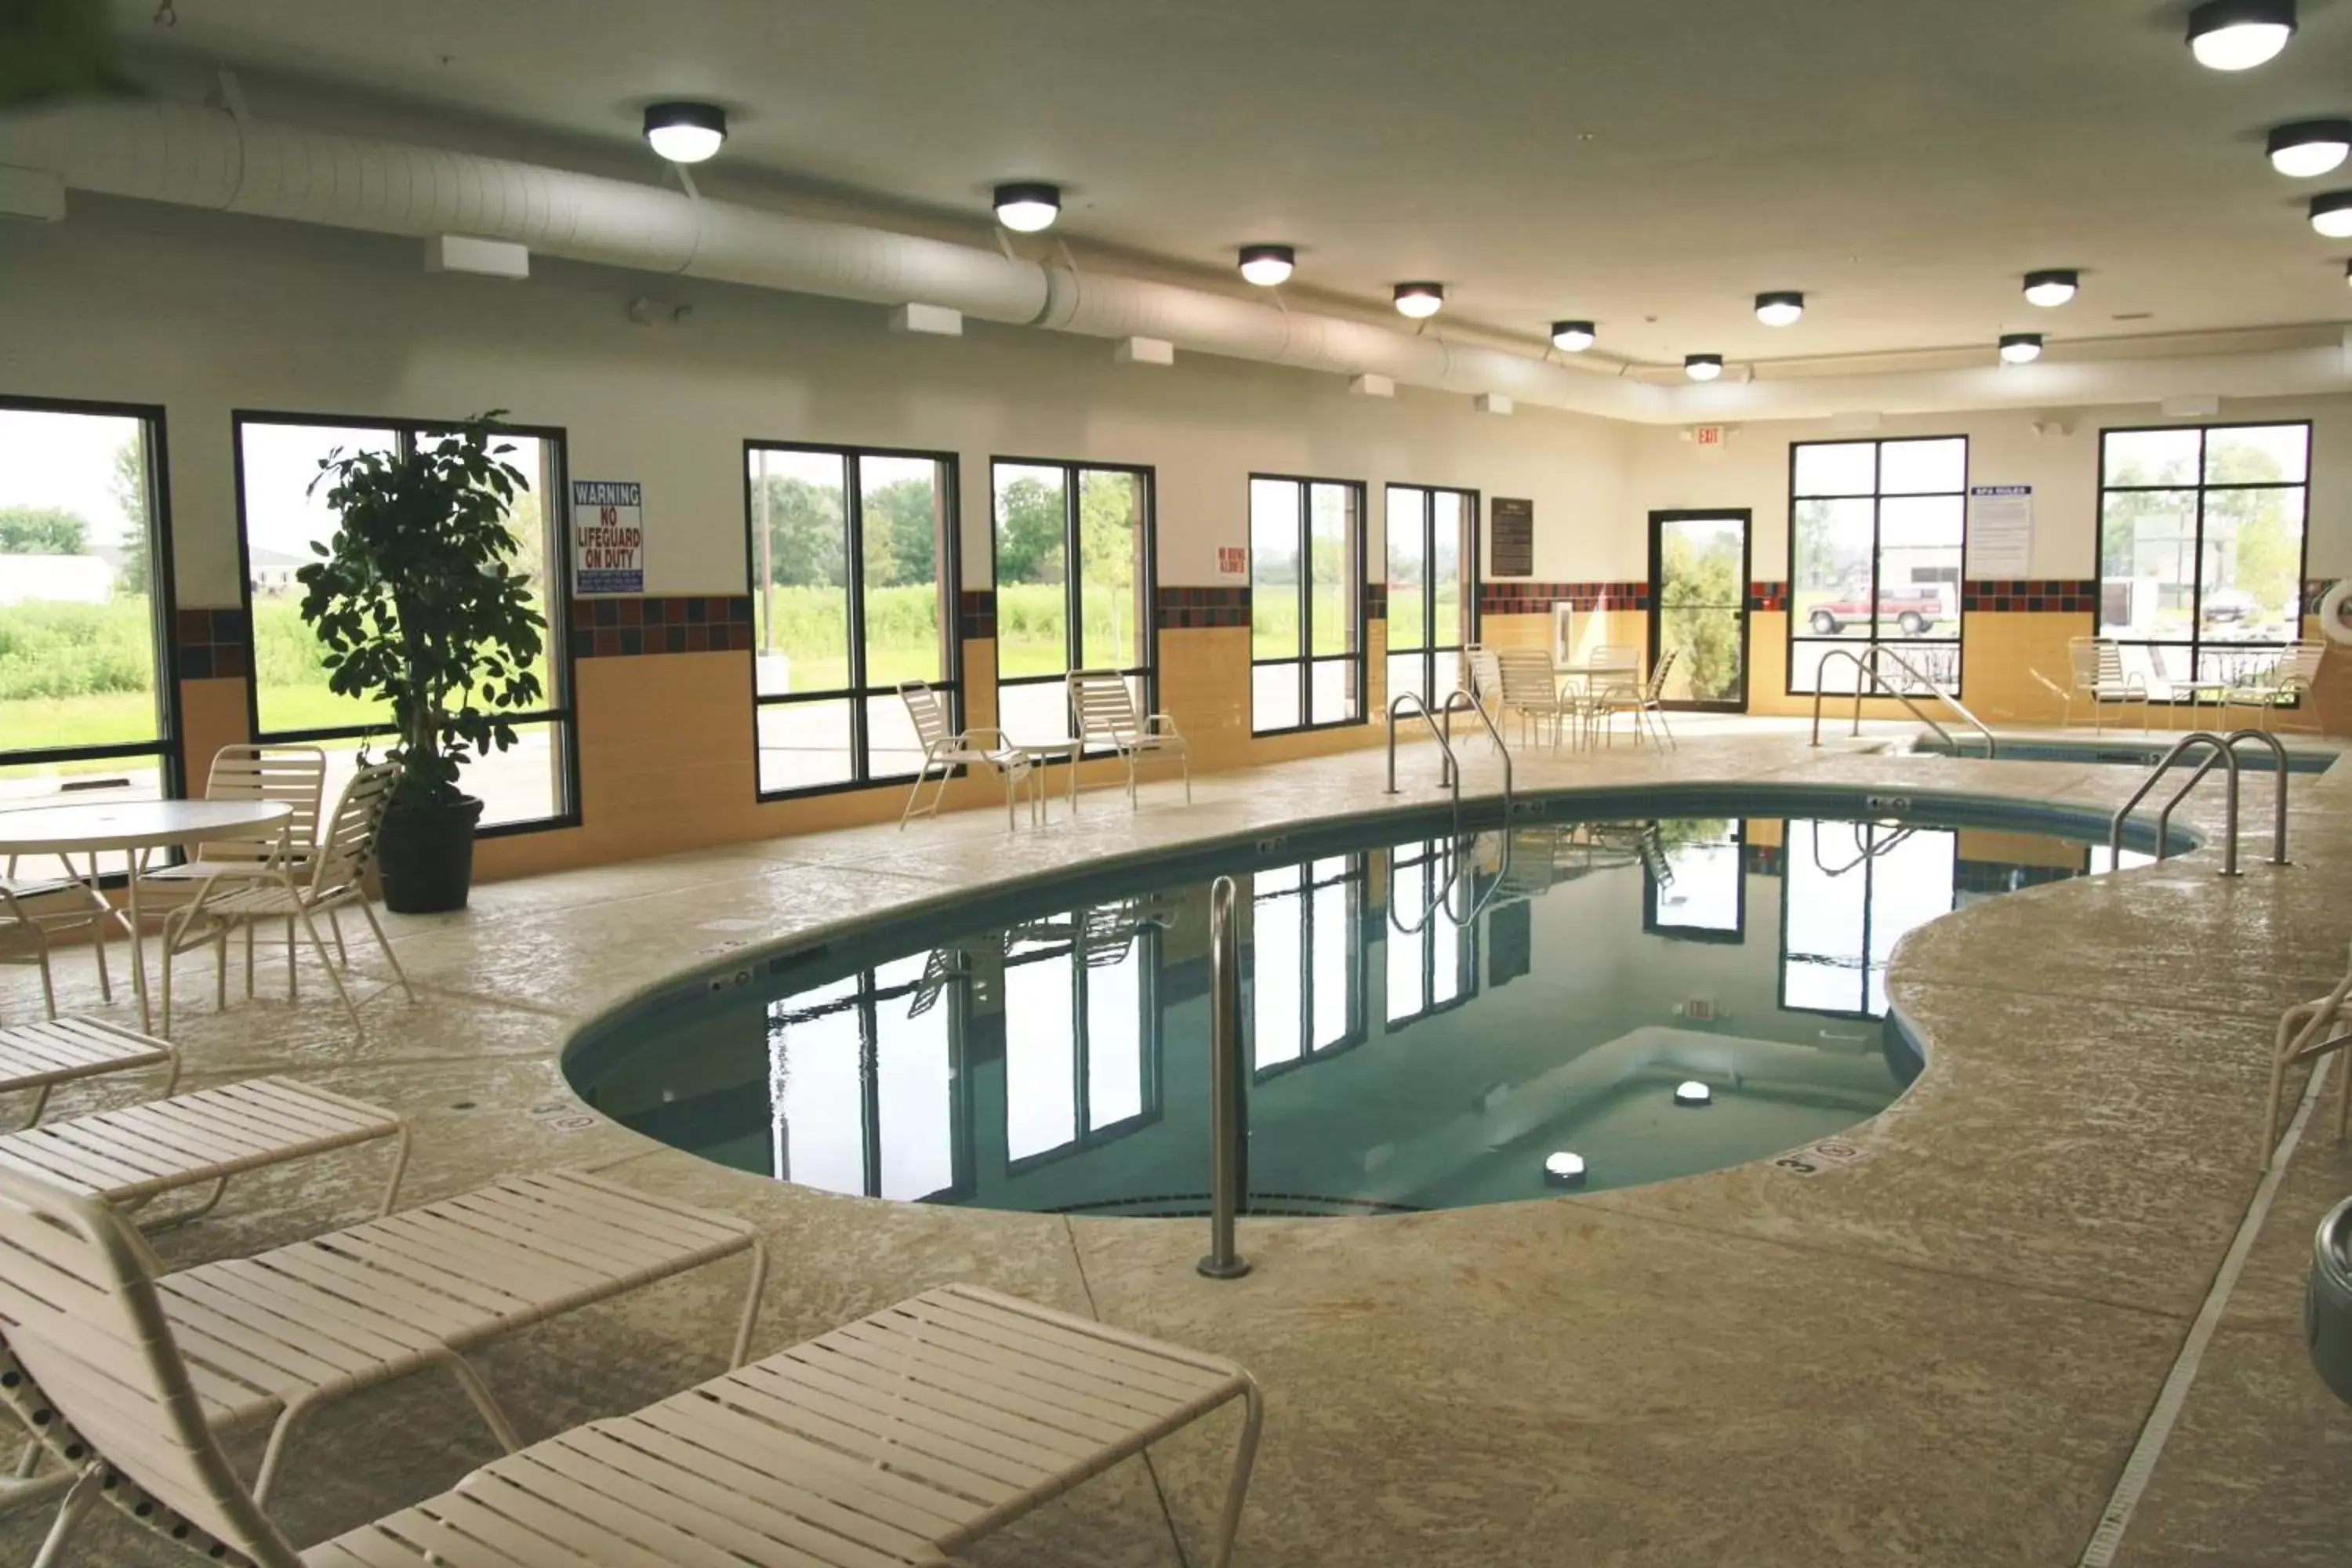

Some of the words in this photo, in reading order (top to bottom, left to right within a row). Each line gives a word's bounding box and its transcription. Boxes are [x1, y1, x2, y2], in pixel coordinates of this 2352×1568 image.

[1698, 428, 1718, 444] EXIT
[575, 484, 639, 506] WARNING
[601, 506, 617, 526] NO
[579, 527, 641, 547] LIFEGUARD
[586, 550, 601, 568] ON
[605, 550, 633, 568] DUTY
